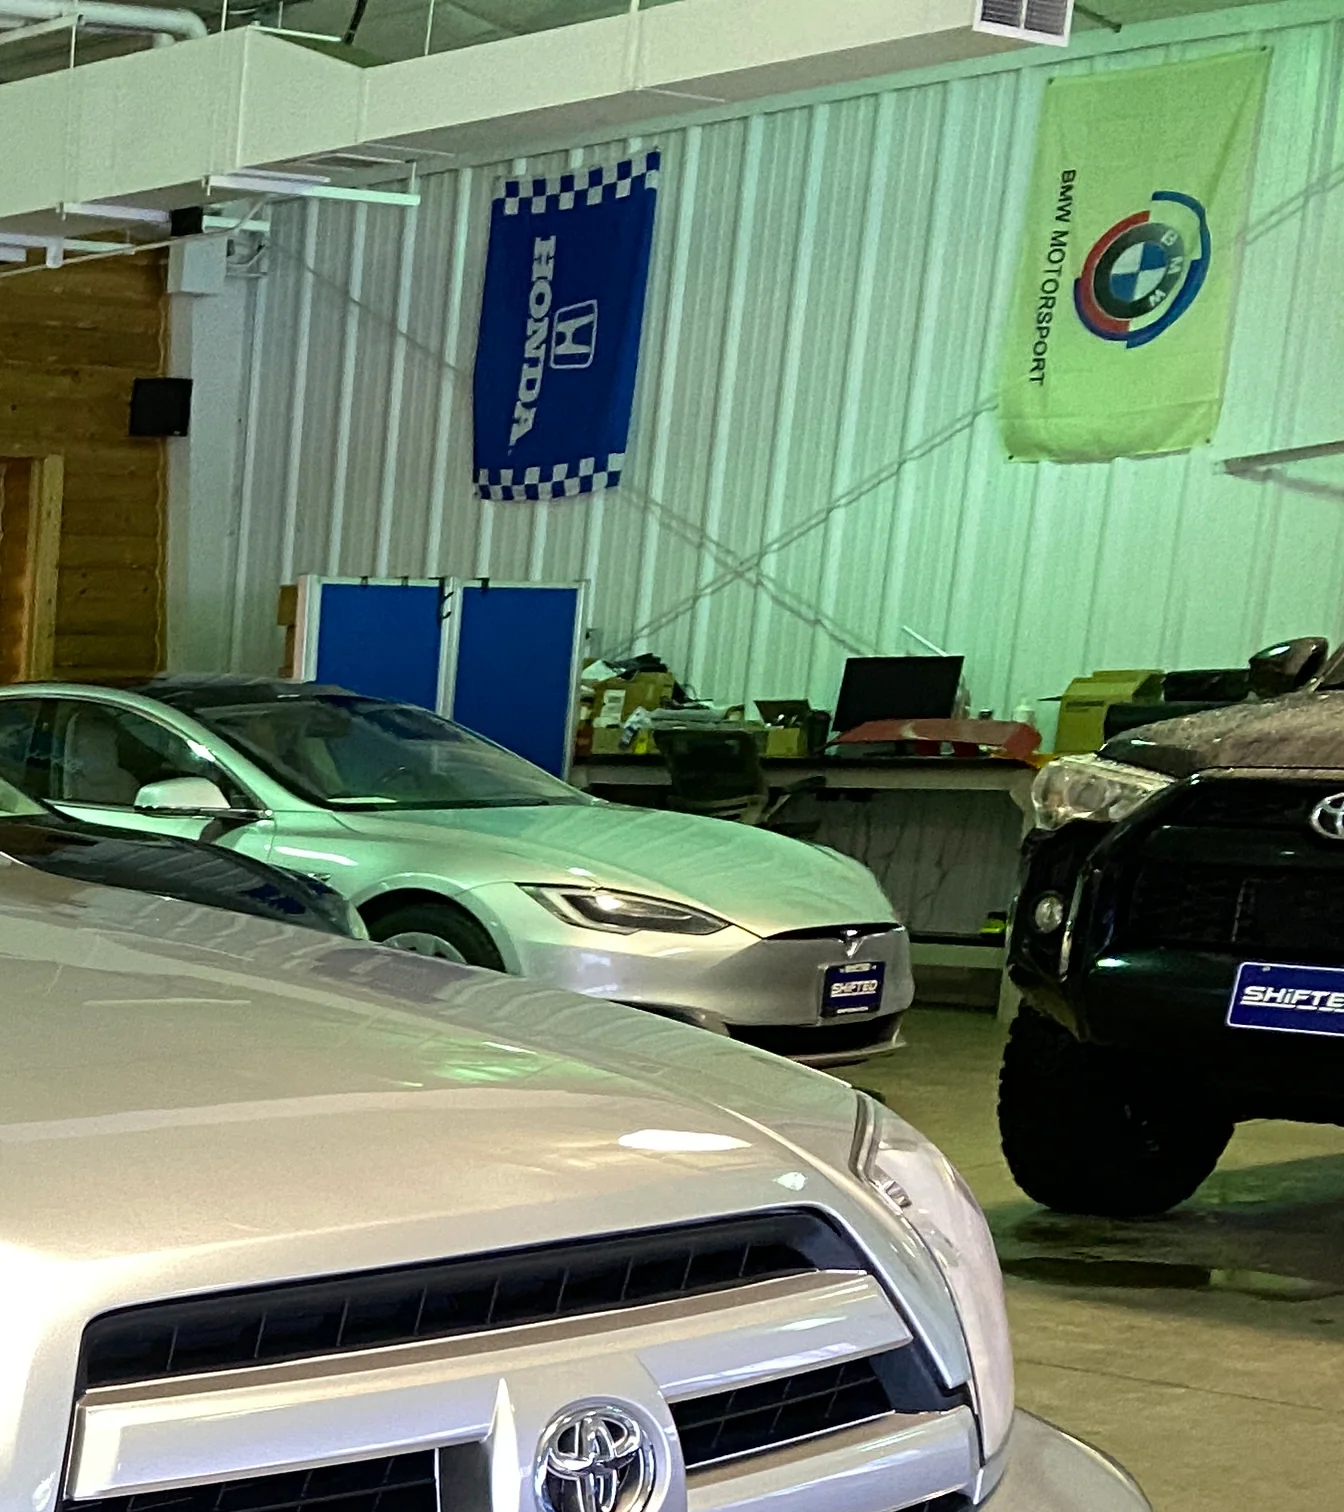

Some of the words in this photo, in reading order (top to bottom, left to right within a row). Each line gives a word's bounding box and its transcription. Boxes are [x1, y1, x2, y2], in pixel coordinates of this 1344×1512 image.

[1054, 168, 1078, 223] BMW
[1148, 228, 1185, 308] BMW
[508, 234, 557, 455] HONDA
[1029, 229, 1070, 388] MOTORSPORT
[1241, 986, 1344, 1009] SHiFTE
